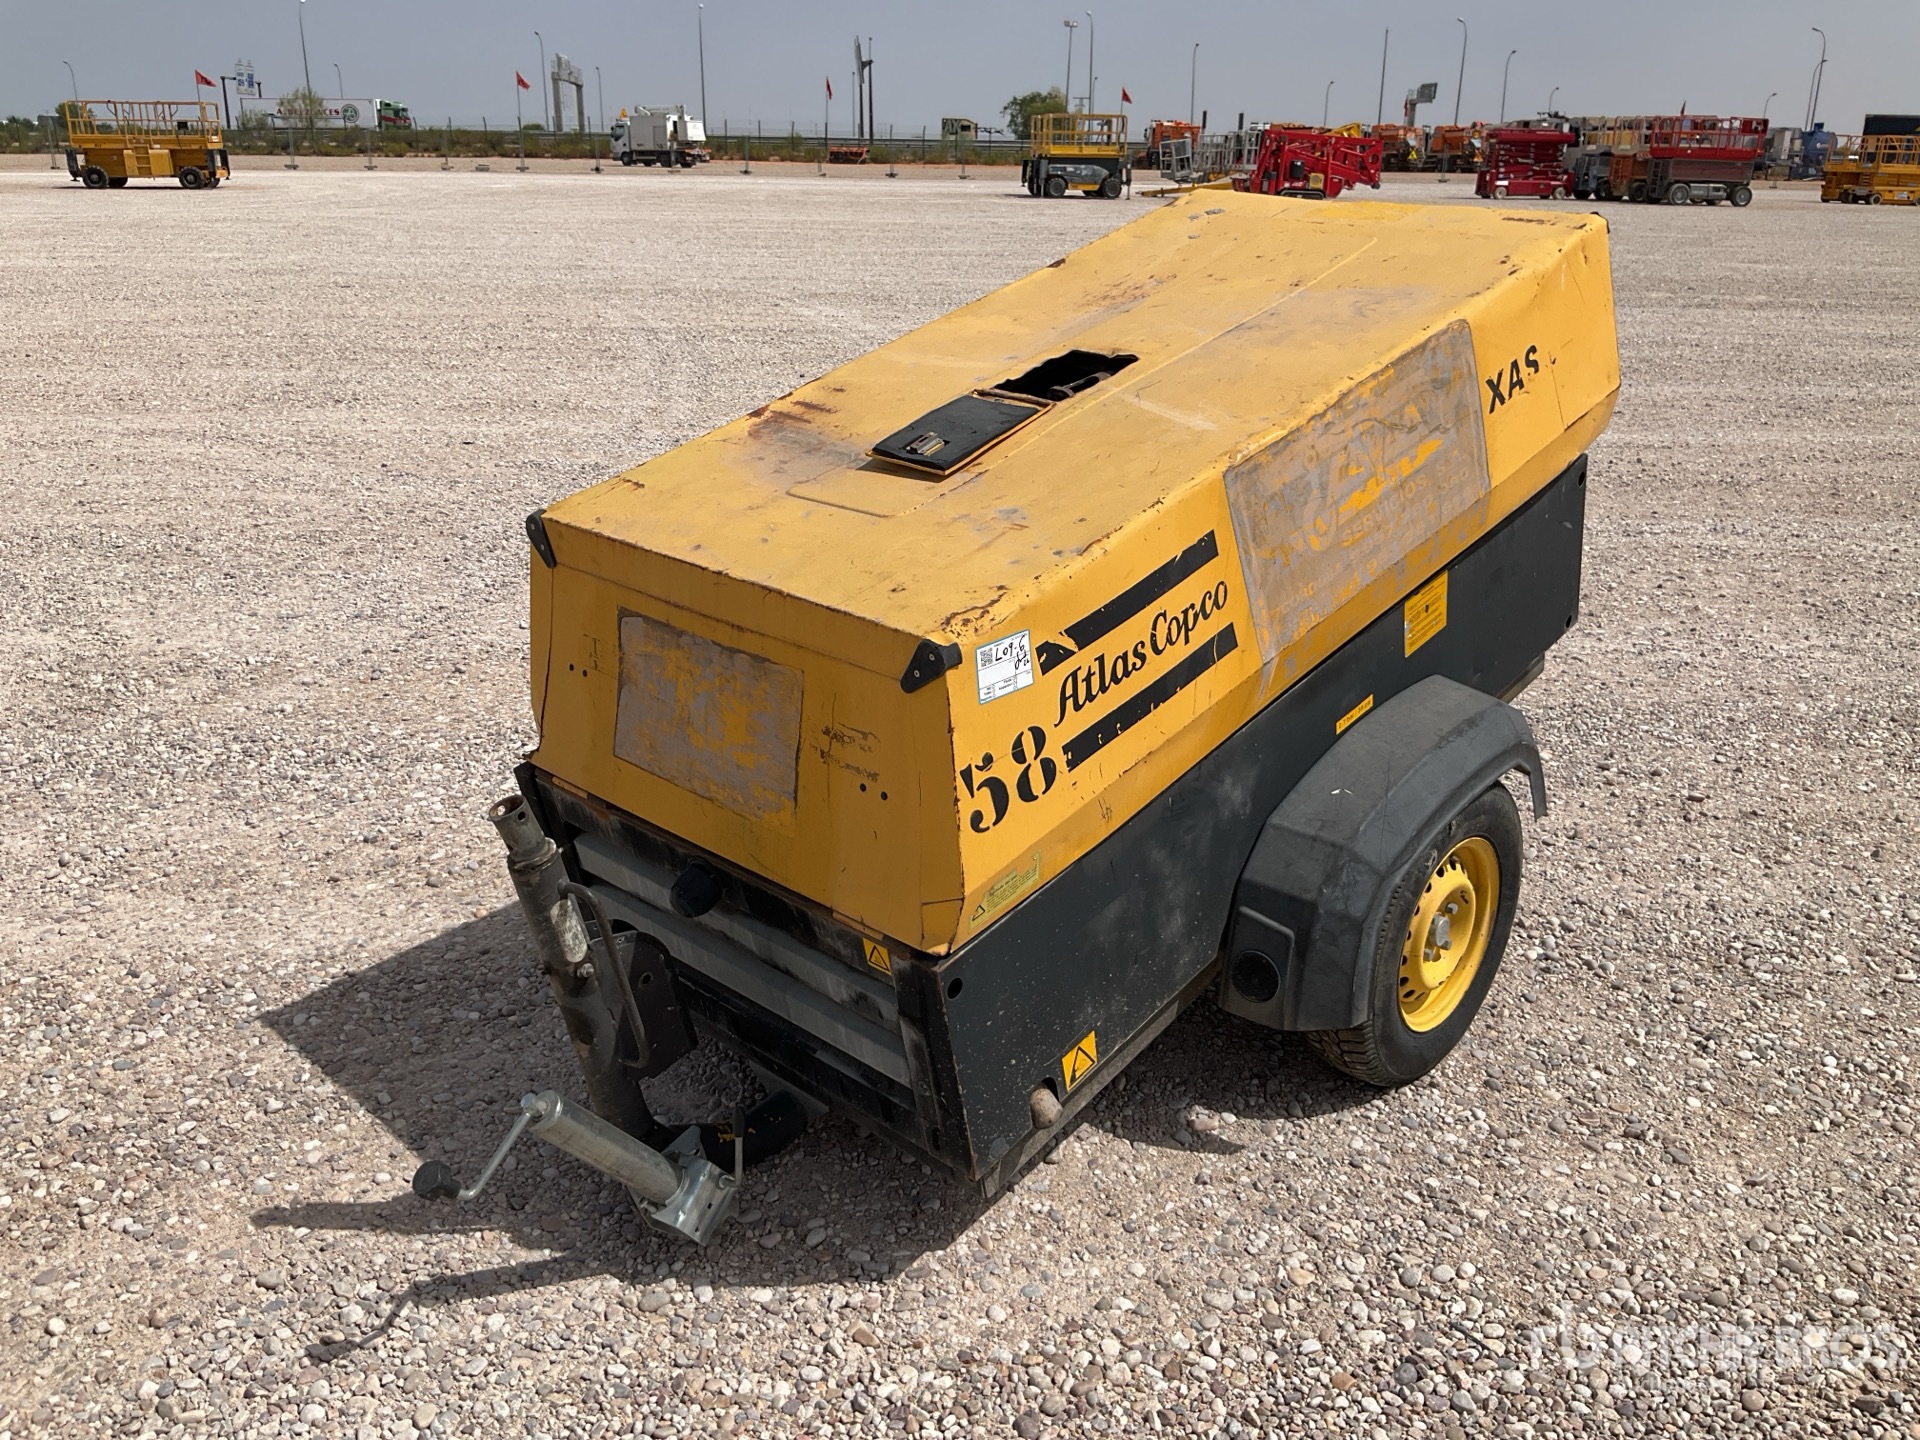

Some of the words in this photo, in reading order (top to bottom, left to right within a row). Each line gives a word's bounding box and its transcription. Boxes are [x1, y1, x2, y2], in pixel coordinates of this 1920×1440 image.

[1485, 344, 1540, 414] XAS
[1053, 638, 1148, 729] Atlas
[1149, 580, 1228, 657] Copco
[959, 725, 1057, 834] 58
